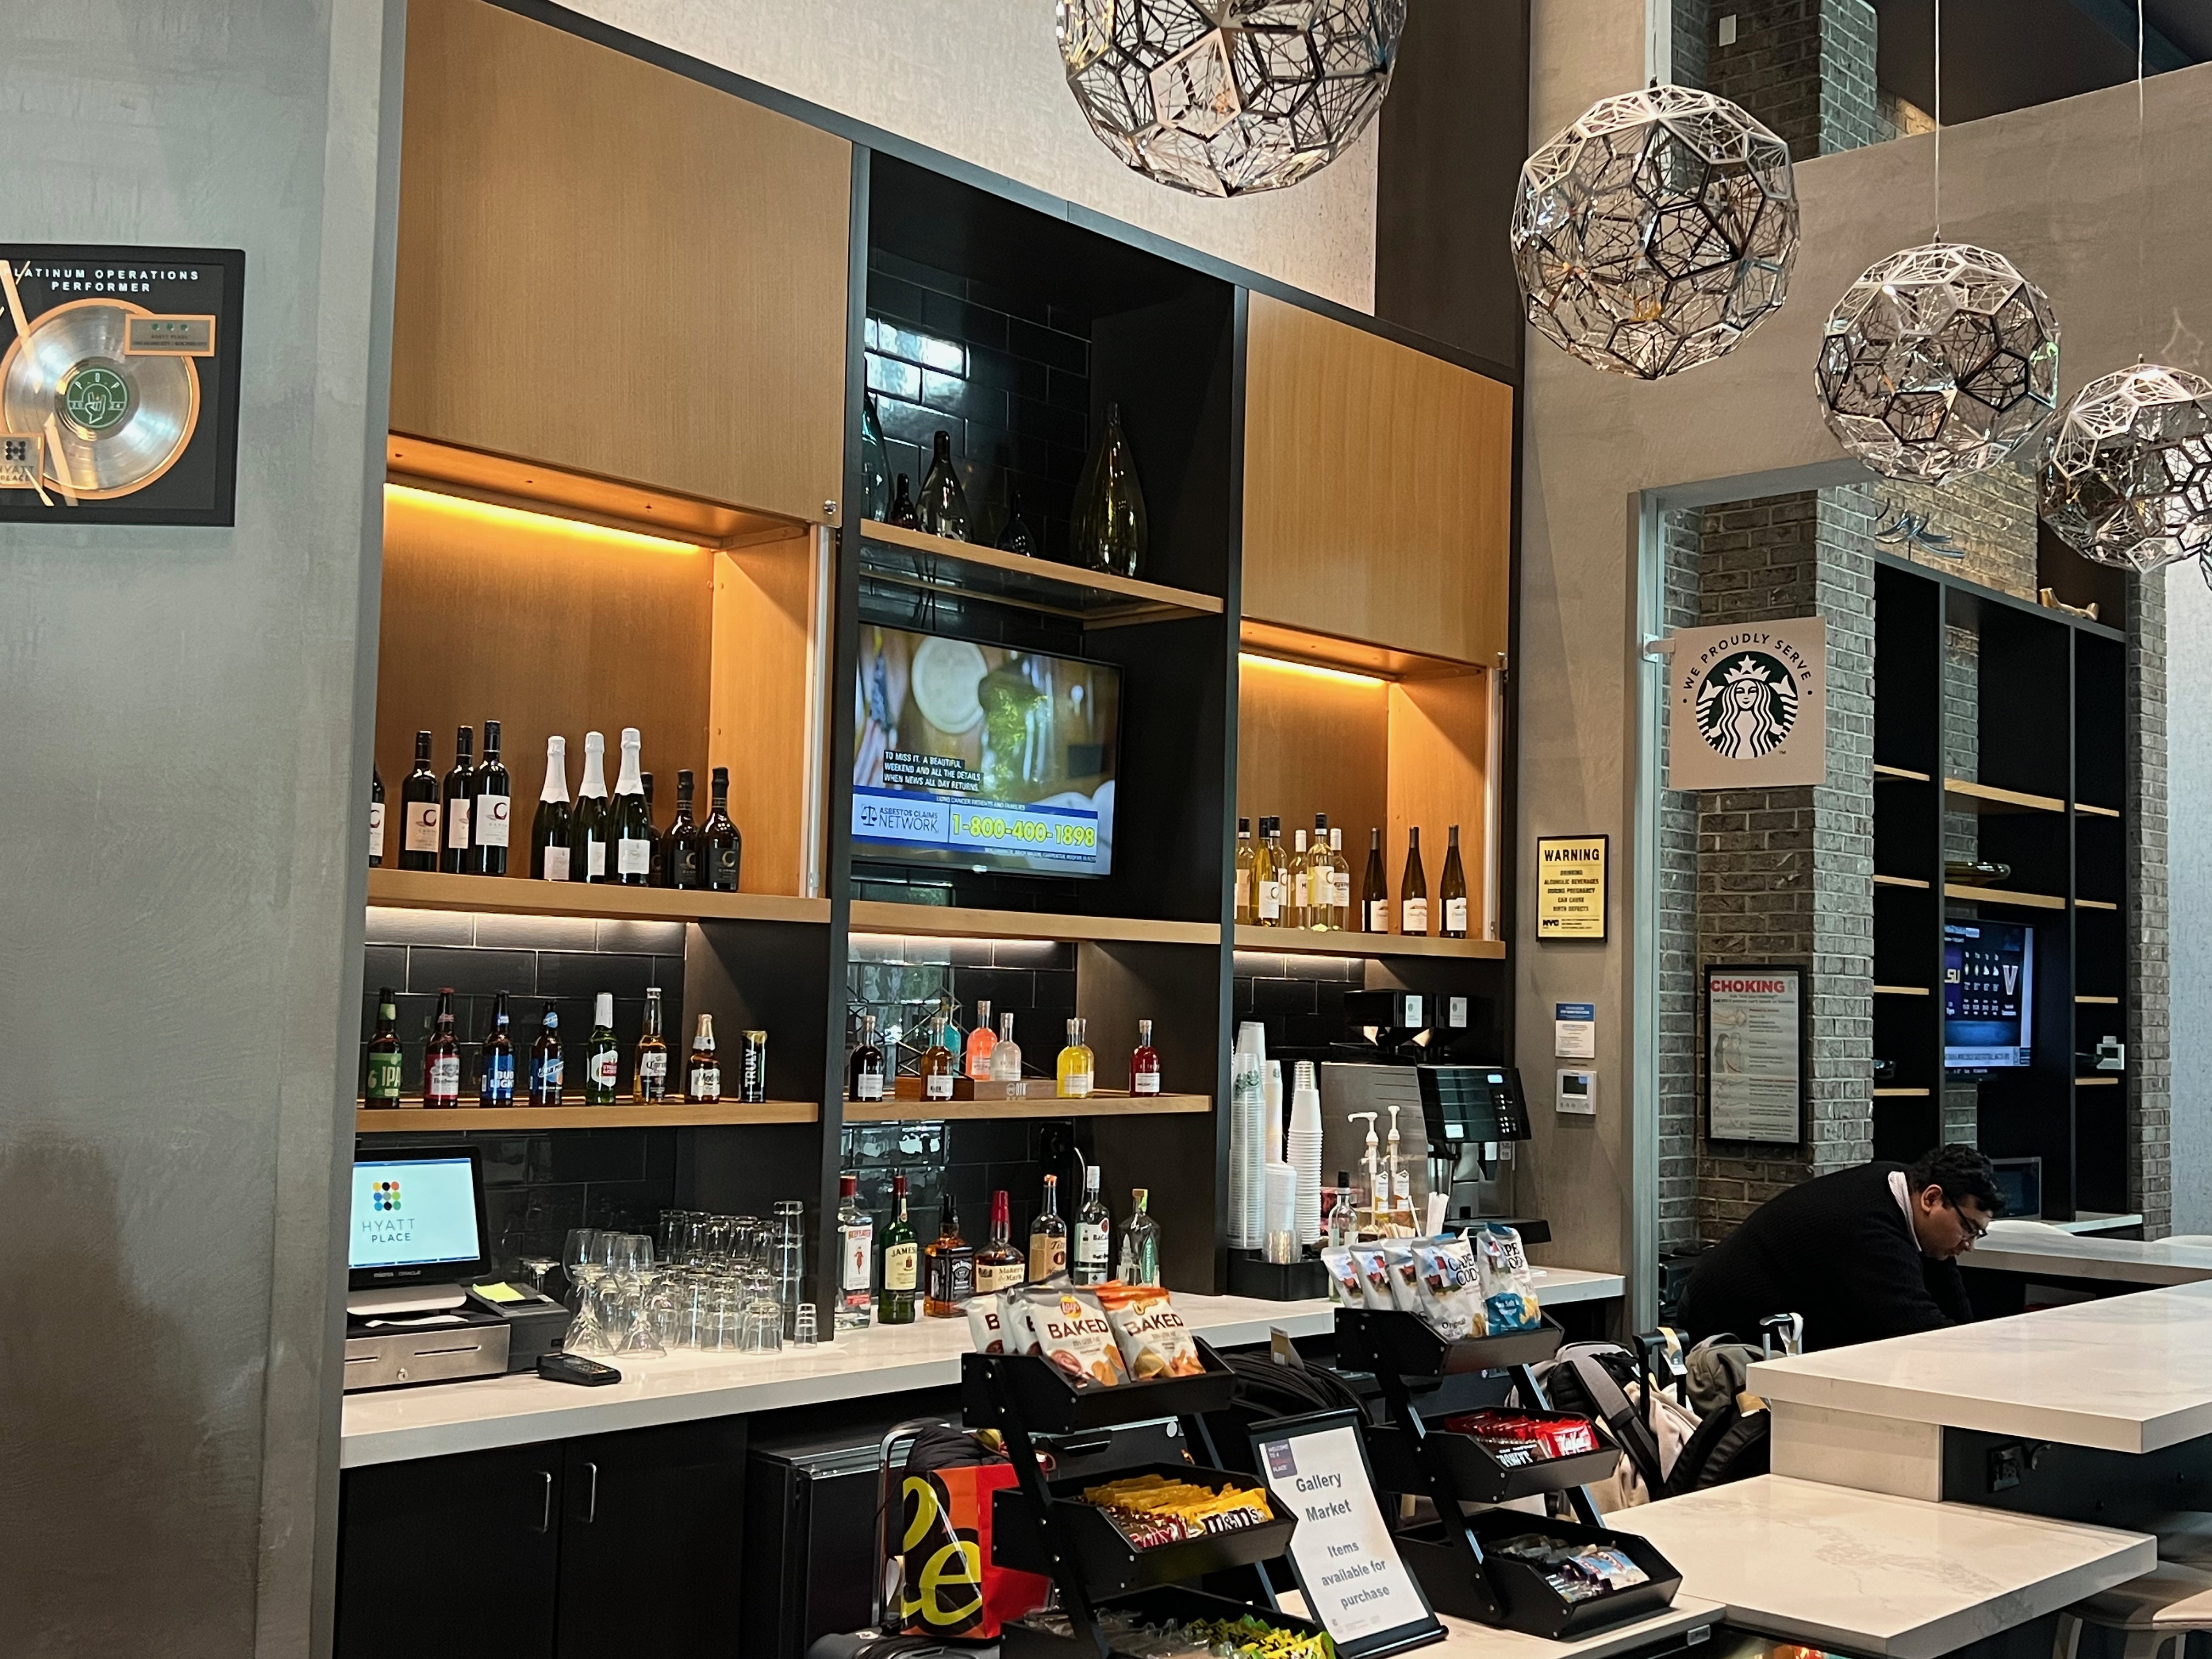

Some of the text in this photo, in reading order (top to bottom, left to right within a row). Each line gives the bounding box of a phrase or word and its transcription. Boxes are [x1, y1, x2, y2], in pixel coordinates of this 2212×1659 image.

[14, 268, 199, 281] LATINUM OPERATIONS
[51, 281, 150, 292] PERFORMER
[1683, 633, 1812, 690] WE PROUDLY SERVE
[885, 751, 894, 760] TO
[895, 752, 911, 763] MISS
[930, 757, 962, 768] BEAUTIFUL
[884, 774, 904, 782] WHEN
[905, 776, 923, 786] NEWS
[925, 778, 936, 787] ALL
[938, 779, 950, 788] DAY
[885, 763, 980, 781] WEEKEND AND ALL THE DETAILS
[879, 807, 938, 819] ASBESTOS CLAIMS
[878, 815, 939, 833] NETWORK
[1544, 848, 1600, 861] WARNING
[1710, 979, 1785, 994] CHOKING
[381, 1066, 401, 1087] IPA
[744, 1048, 758, 1087] TRULY
[362, 1218, 415, 1233] HYATT
[371, 1232, 411, 1243] PLACE
[1448, 1253, 1475, 1272] CAPE
[1456, 1268, 1478, 1286] COD
[1047, 1318, 1109, 1339] BAKED
[1123, 1313, 1184, 1336] BAKED
[1268, 1443, 1288, 1453] WELCOME
[1296, 1473, 1342, 1493] Gallery
[1305, 1498, 1352, 1522] Market
[1327, 1540, 1359, 1558] Items
[1321, 1559, 1386, 1587] available for
[1340, 1584, 1390, 1611] purchase
